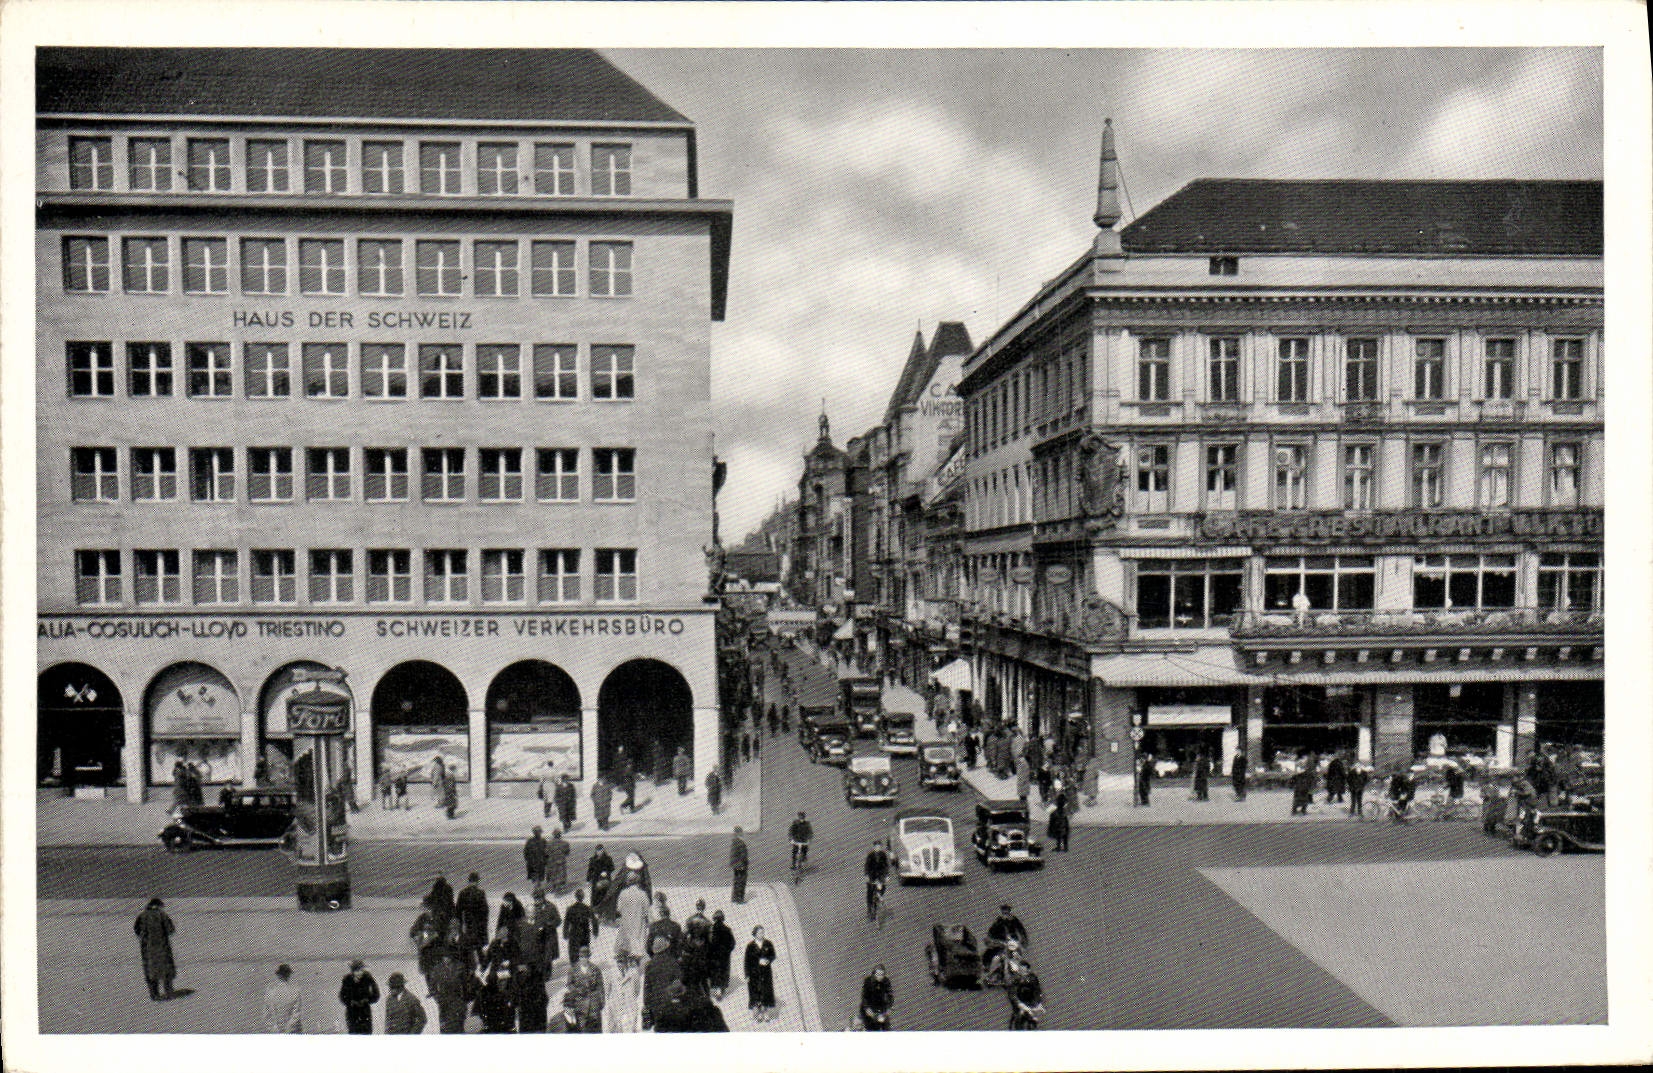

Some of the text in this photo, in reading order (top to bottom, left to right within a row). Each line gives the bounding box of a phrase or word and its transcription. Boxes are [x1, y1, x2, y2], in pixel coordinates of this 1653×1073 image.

[232, 311, 473, 329] HAUS DER SCHWEIZ
[256, 619, 345, 638] TRIESTINO
[376, 614, 685, 637] SCHWEIZER VERKEHRSBÜRO
[290, 702, 347, 729] Ford
